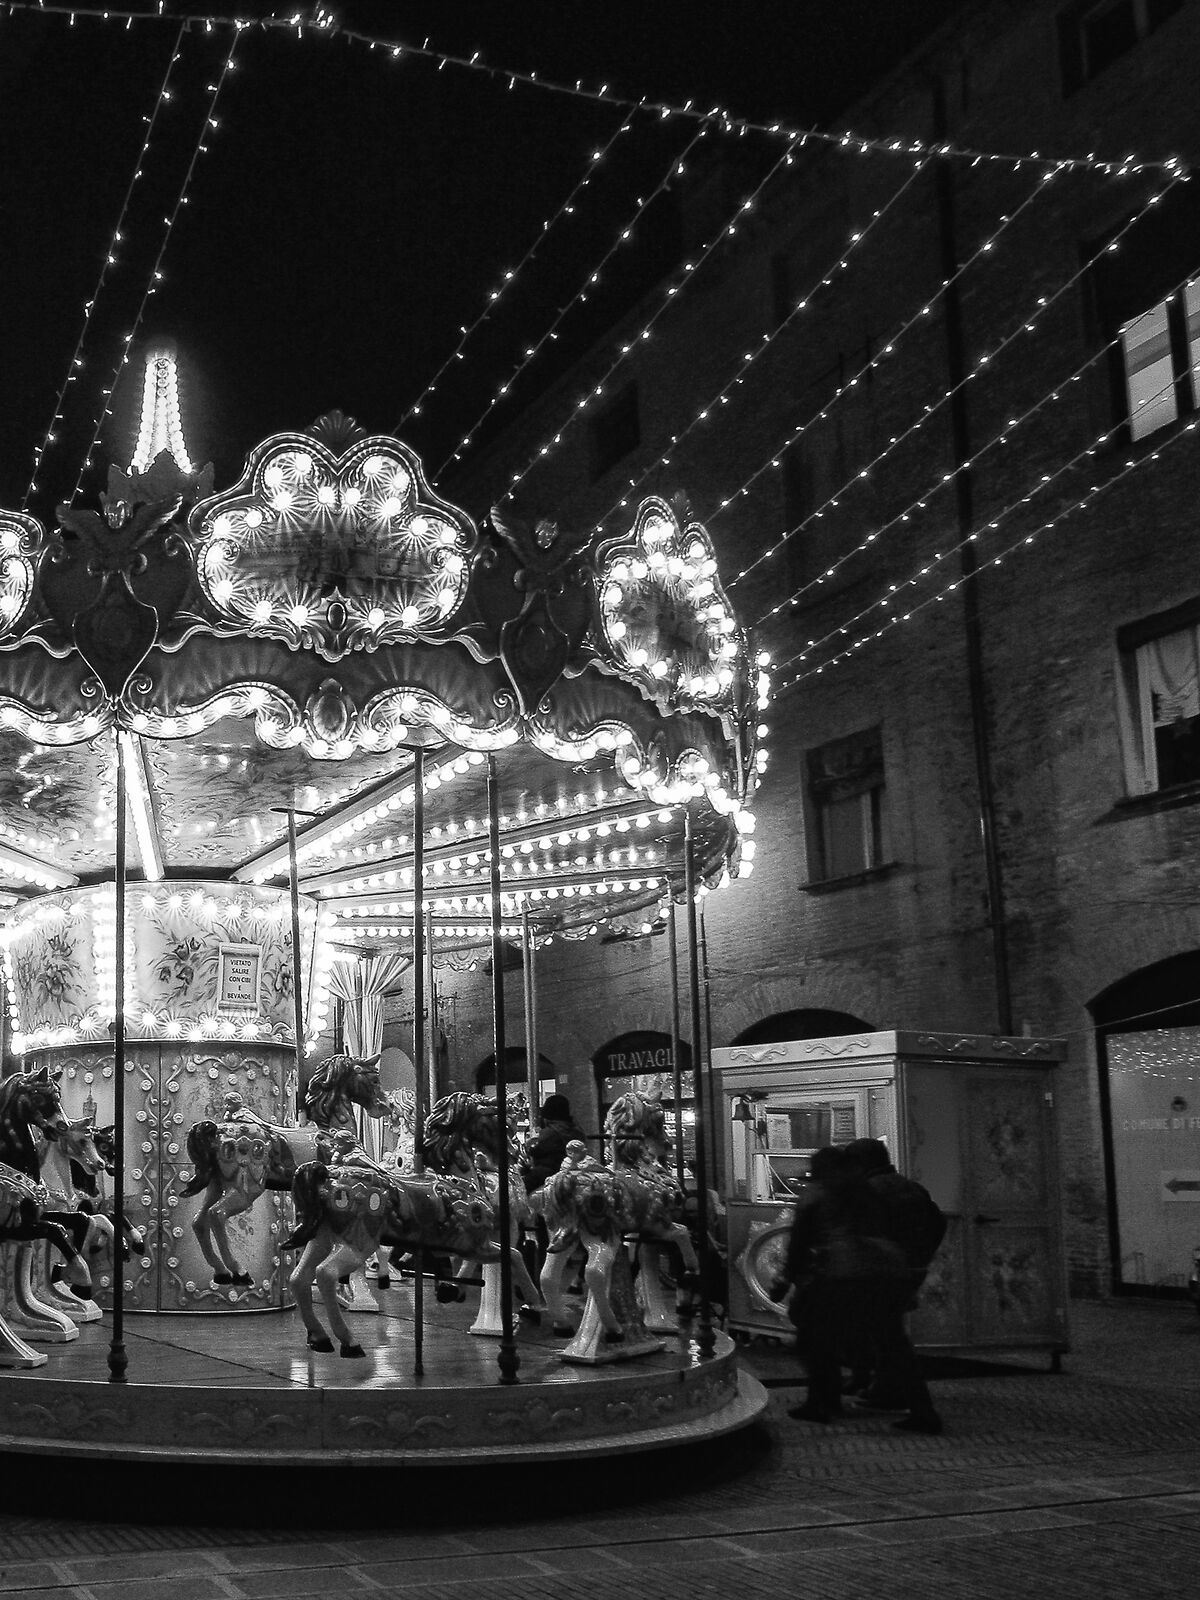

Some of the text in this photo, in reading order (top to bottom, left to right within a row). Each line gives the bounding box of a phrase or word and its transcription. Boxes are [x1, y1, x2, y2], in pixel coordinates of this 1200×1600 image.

[230, 959, 252, 967] VIETATO
[231, 967, 249, 975] SALIRE
[227, 992, 251, 1000] BEVANDE
[607, 1047, 676, 1071] TRAVAGL
